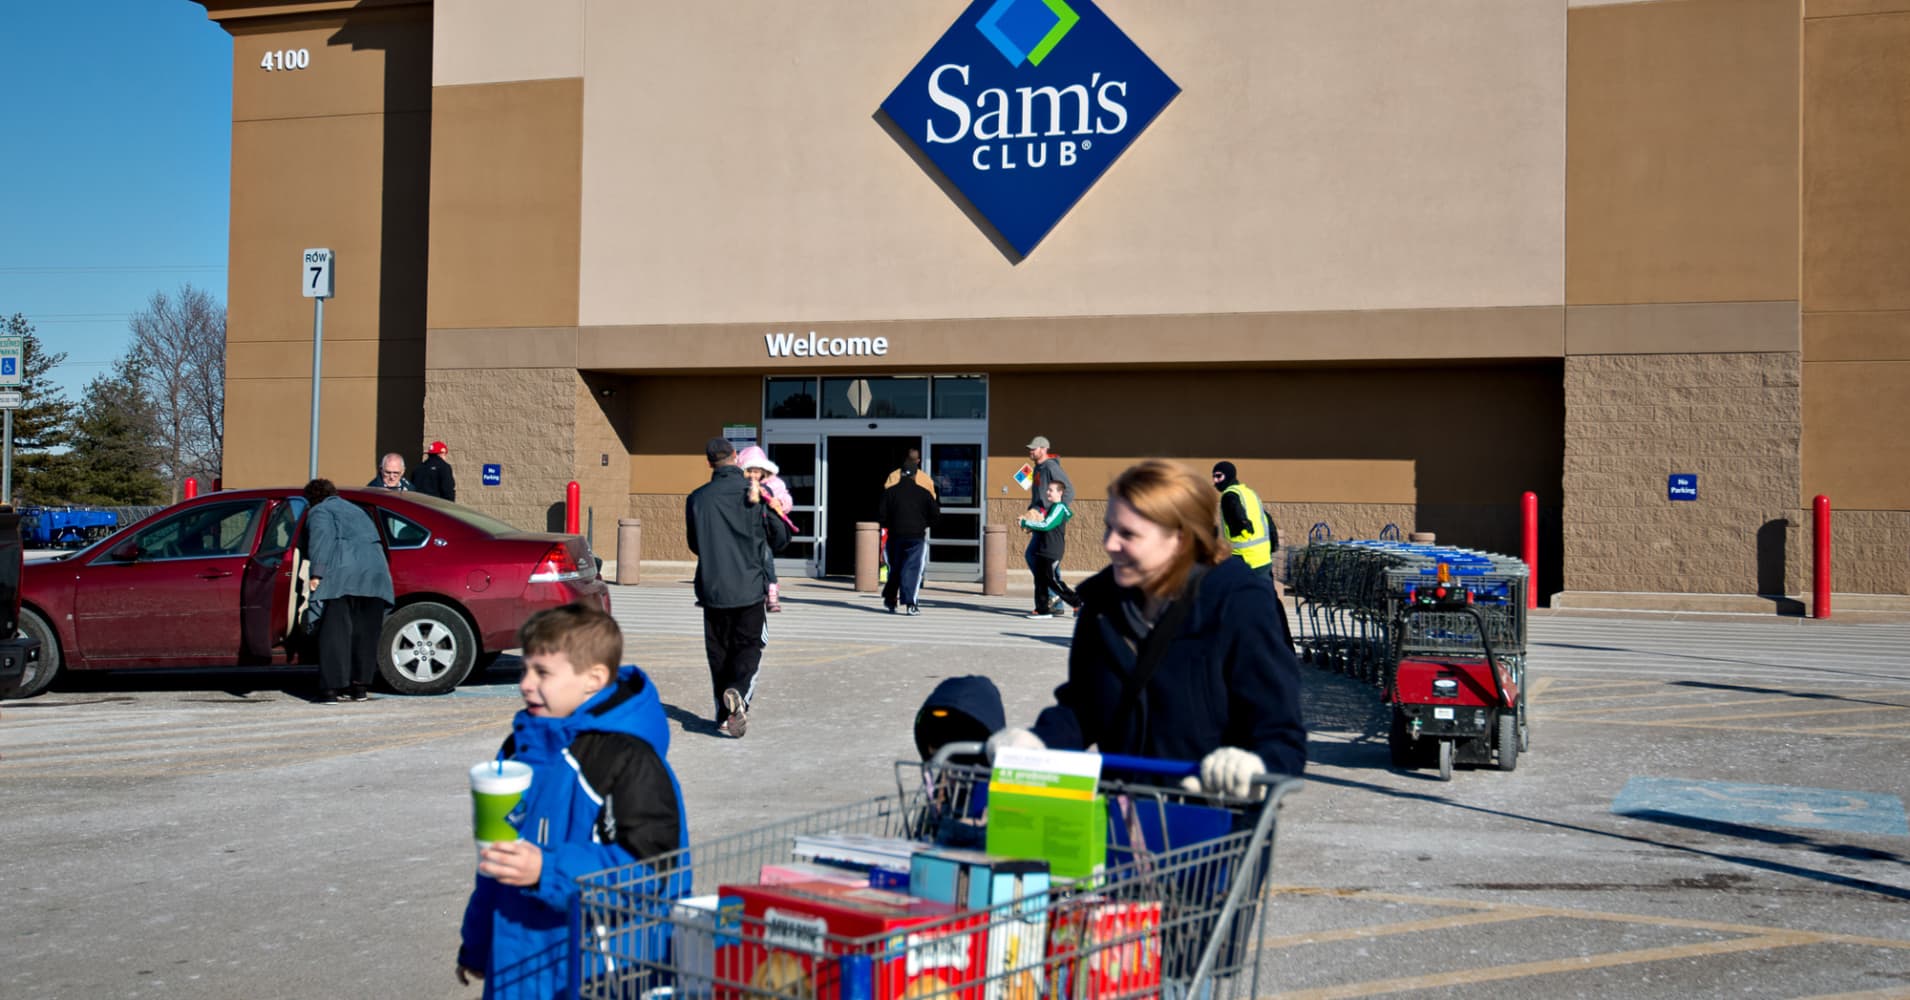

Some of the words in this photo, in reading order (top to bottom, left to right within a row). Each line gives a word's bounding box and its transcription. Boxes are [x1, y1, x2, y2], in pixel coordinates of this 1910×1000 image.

[260, 48, 310, 71] 4100
[926, 63, 1129, 144] Sam's
[305, 252, 328, 263] ROW
[309, 266, 323, 289] 7
[765, 331, 889, 357] Welcome
